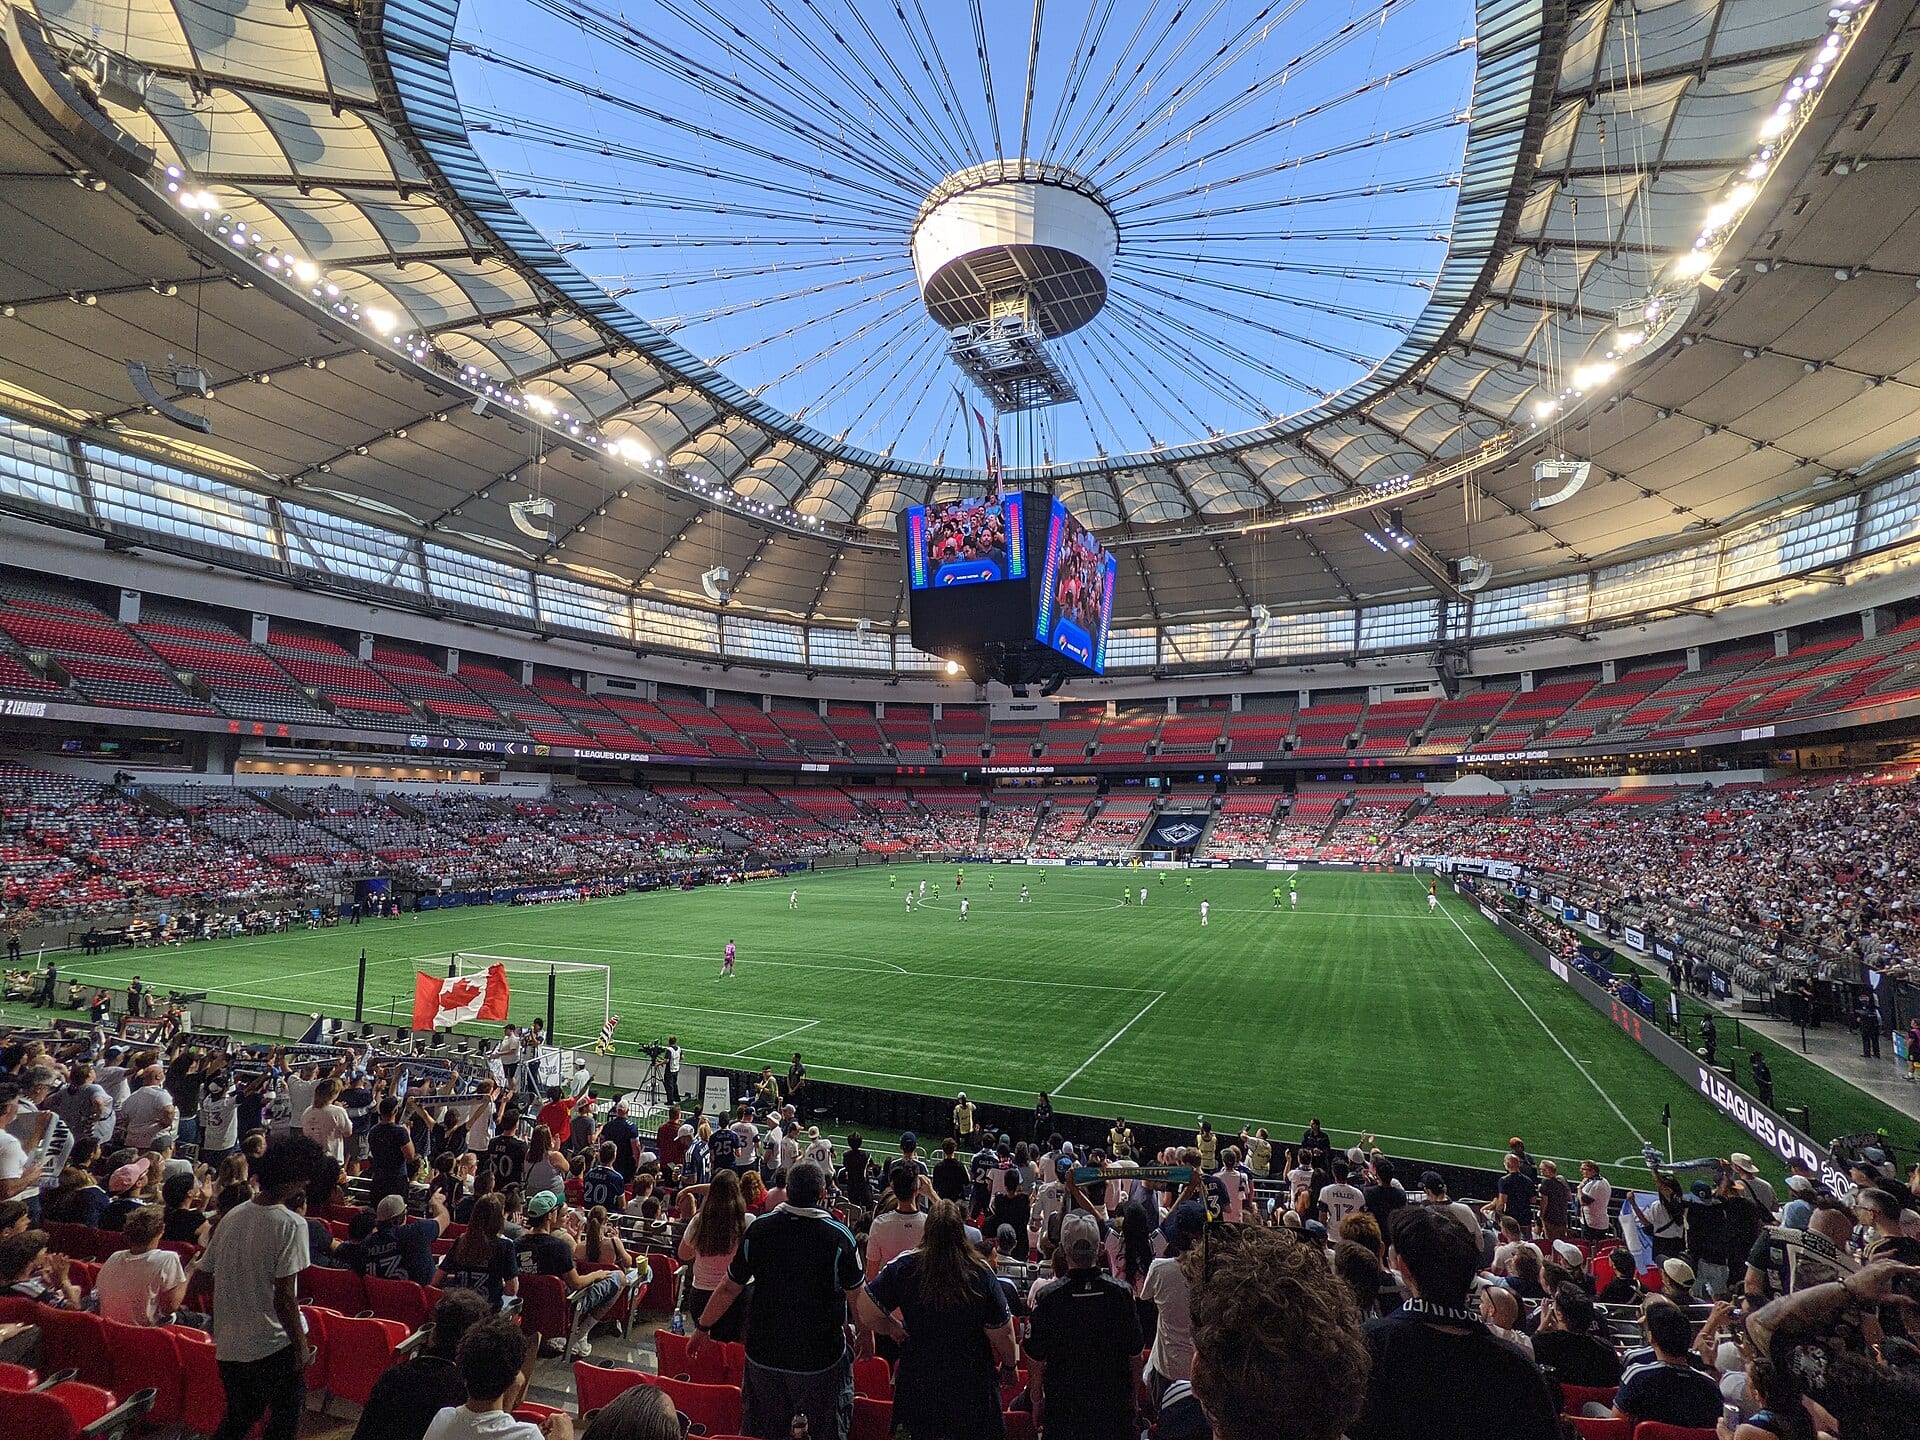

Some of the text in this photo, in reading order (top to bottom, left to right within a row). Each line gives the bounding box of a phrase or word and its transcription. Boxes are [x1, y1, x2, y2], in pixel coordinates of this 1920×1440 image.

[5, 700, 14, 714] 2
[443, 738, 528, 754] 0 0:01 0
[580, 749, 615, 760] LEAGUES
[615, 753, 630, 761] CUP
[1464, 753, 1505, 763] LEAGUES
[1506, 752, 1526, 760] CUP
[1710, 1075, 1776, 1148] LEAGUES
[1778, 1128, 1818, 1172] CUP
[715, 1140, 731, 1155] 25
[584, 1181, 608, 1204] 20
